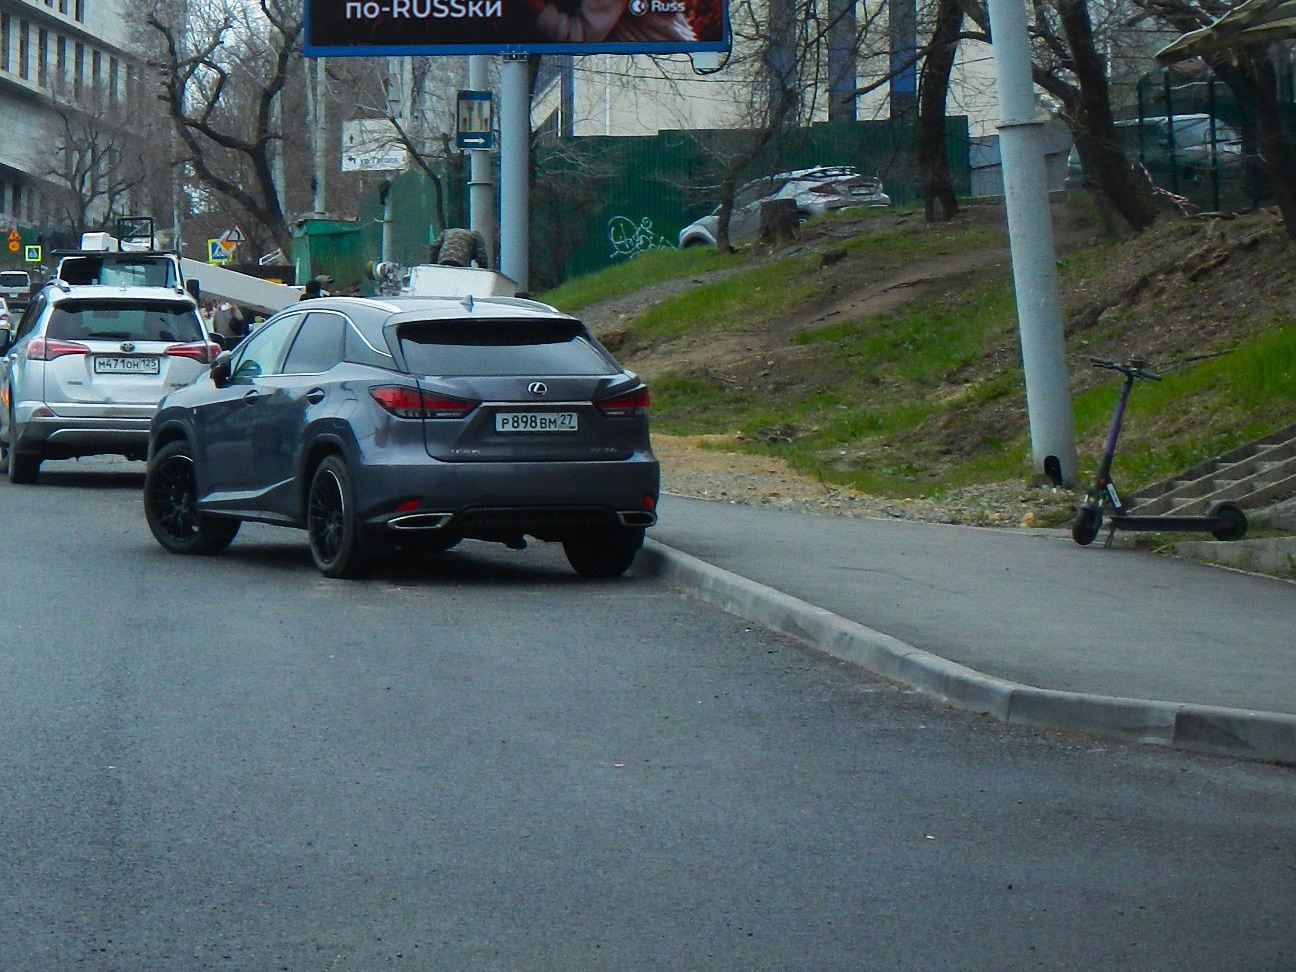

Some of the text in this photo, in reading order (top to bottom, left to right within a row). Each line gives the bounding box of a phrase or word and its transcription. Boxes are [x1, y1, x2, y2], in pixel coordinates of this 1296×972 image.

[650, 0, 686, 13] Russ
[141, 358, 157, 368] 125
[560, 414, 573, 425] 27
